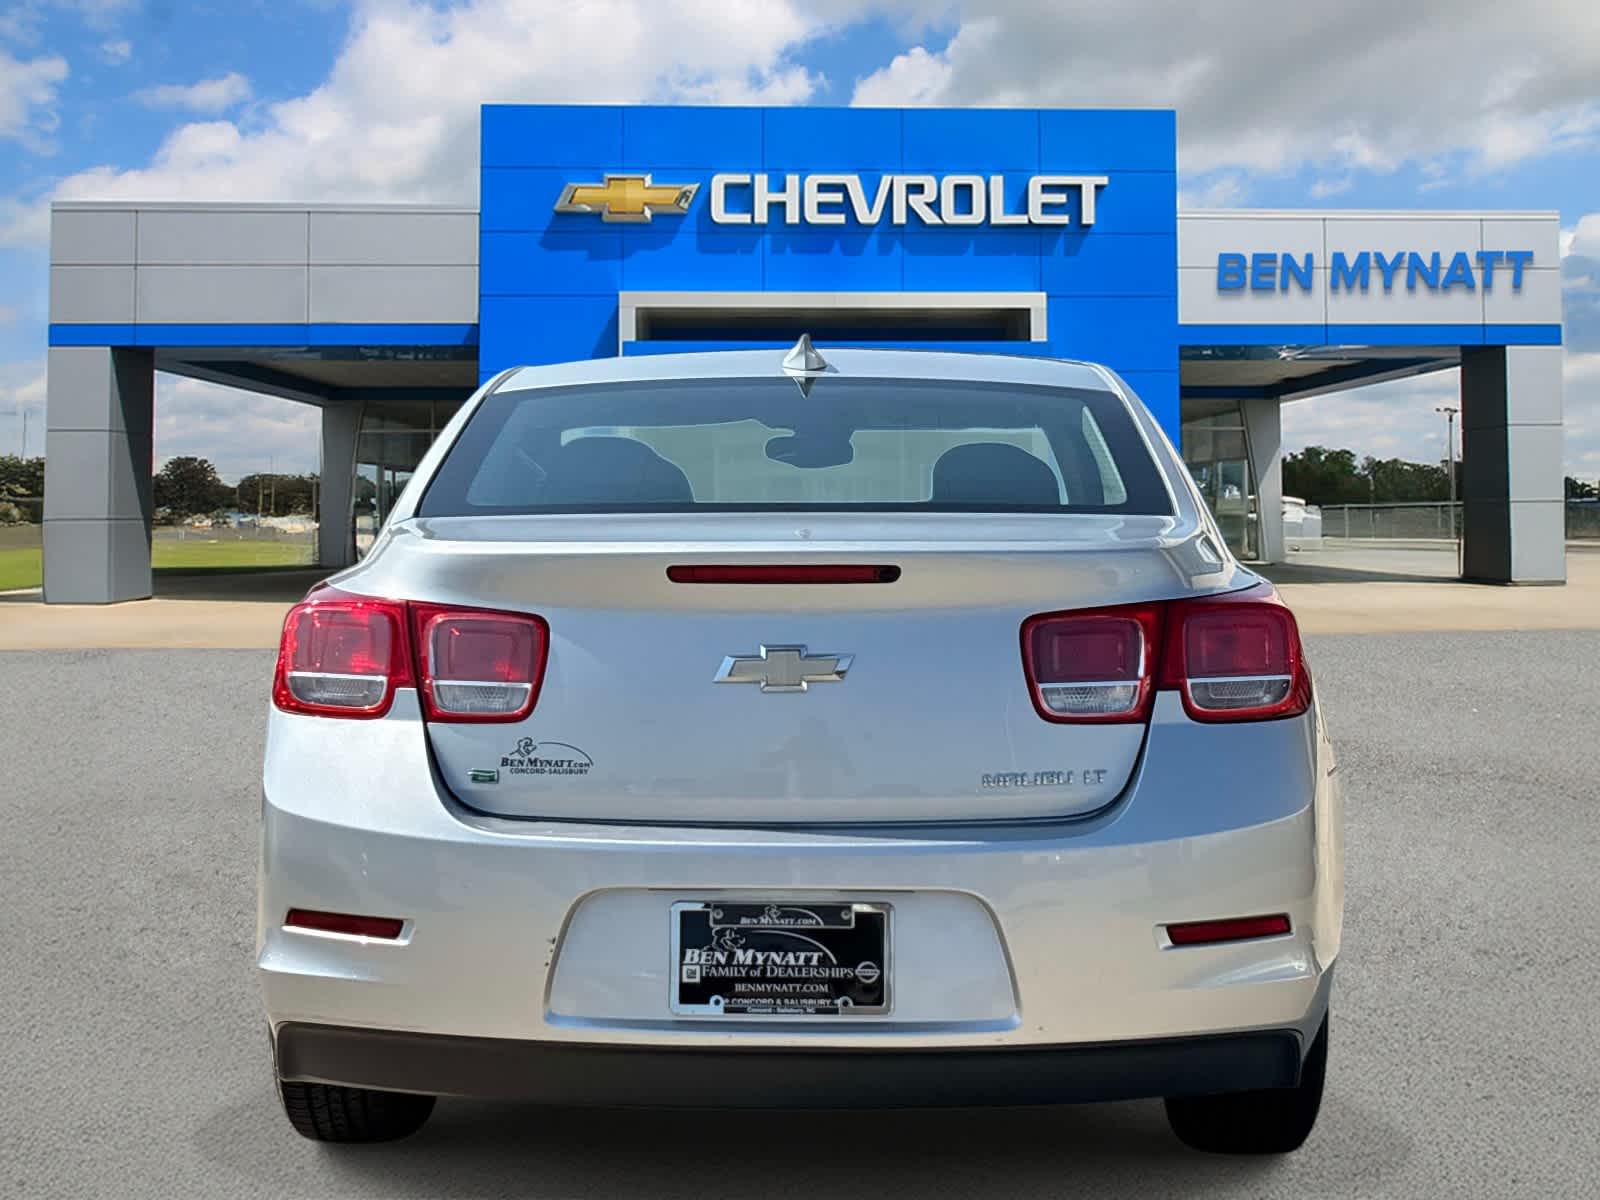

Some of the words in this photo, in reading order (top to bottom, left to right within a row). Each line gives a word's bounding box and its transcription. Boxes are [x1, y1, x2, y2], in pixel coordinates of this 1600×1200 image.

[710, 173, 1110, 225] CHEVROLET
[1217, 252, 1314, 290] BEN
[1330, 250, 1534, 290] MYNATT
[683, 949, 729, 965] BEN
[733, 949, 823, 966] MYNATT
[702, 966, 747, 978] FAMILY
[750, 966, 762, 978] of
[766, 966, 854, 978] DEALERSHIPS
[735, 983, 829, 993] BENMYNATT.COM
